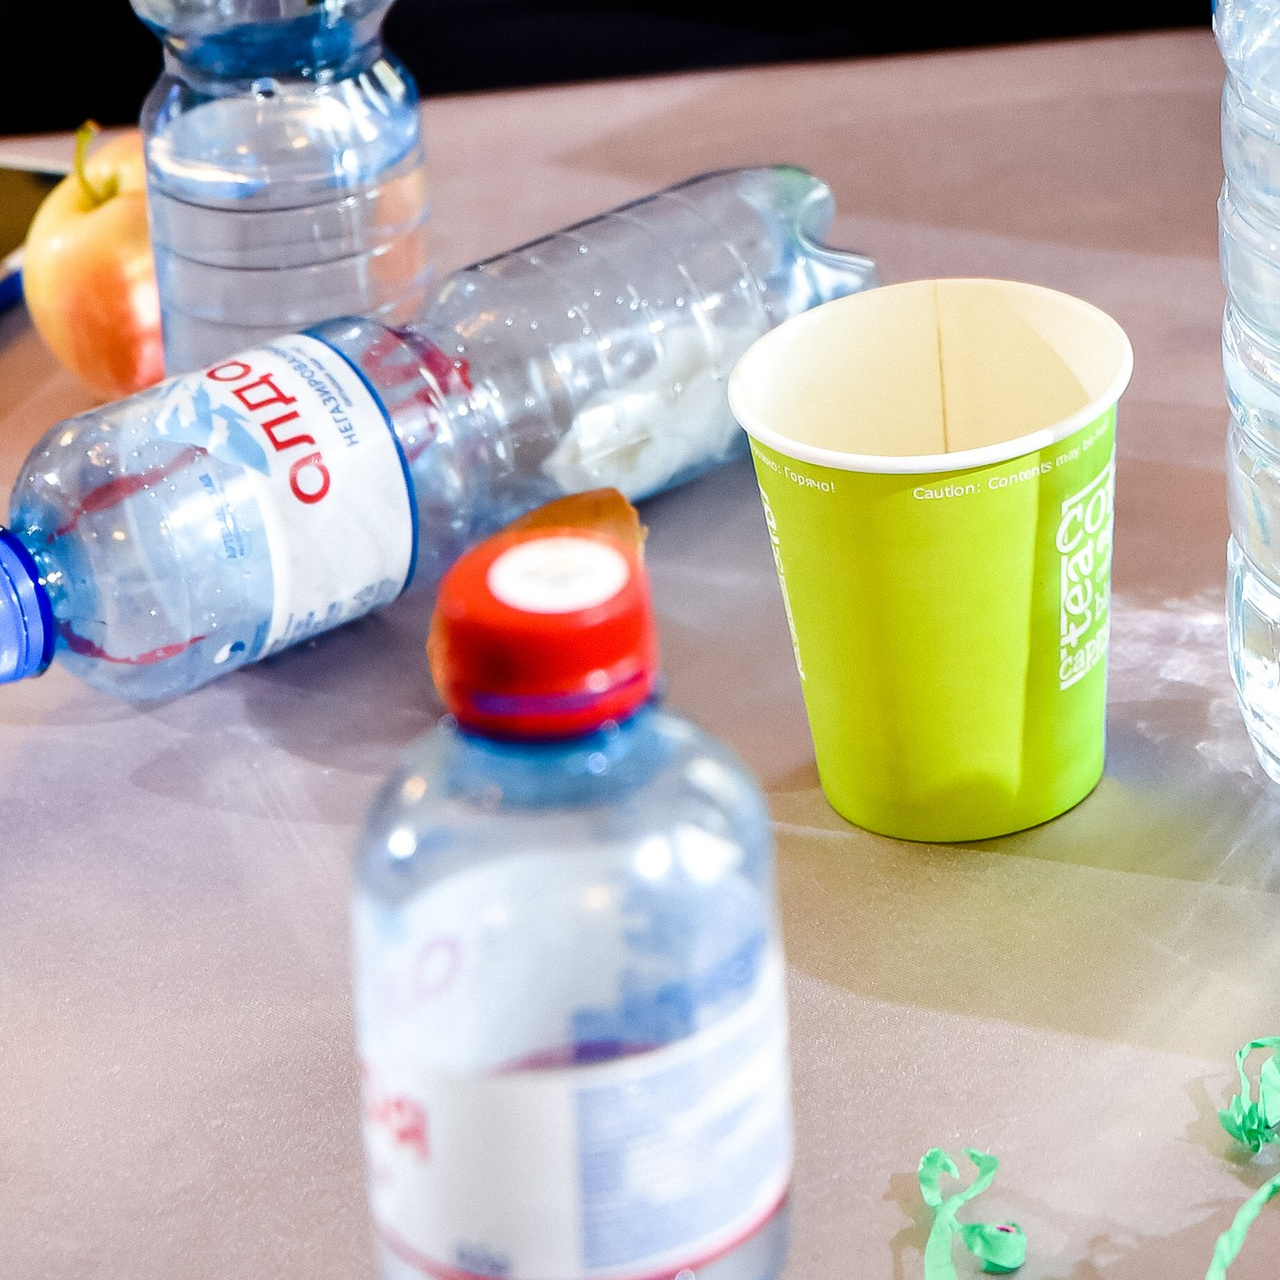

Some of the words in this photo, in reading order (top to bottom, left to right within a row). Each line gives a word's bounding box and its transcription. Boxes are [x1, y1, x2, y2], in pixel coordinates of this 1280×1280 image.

[783, 465, 836, 494] Горячо!
[912, 482, 982, 501] Caution:
[987, 461, 1053, 491] Contents
[1060, 538, 1094, 649] tea
